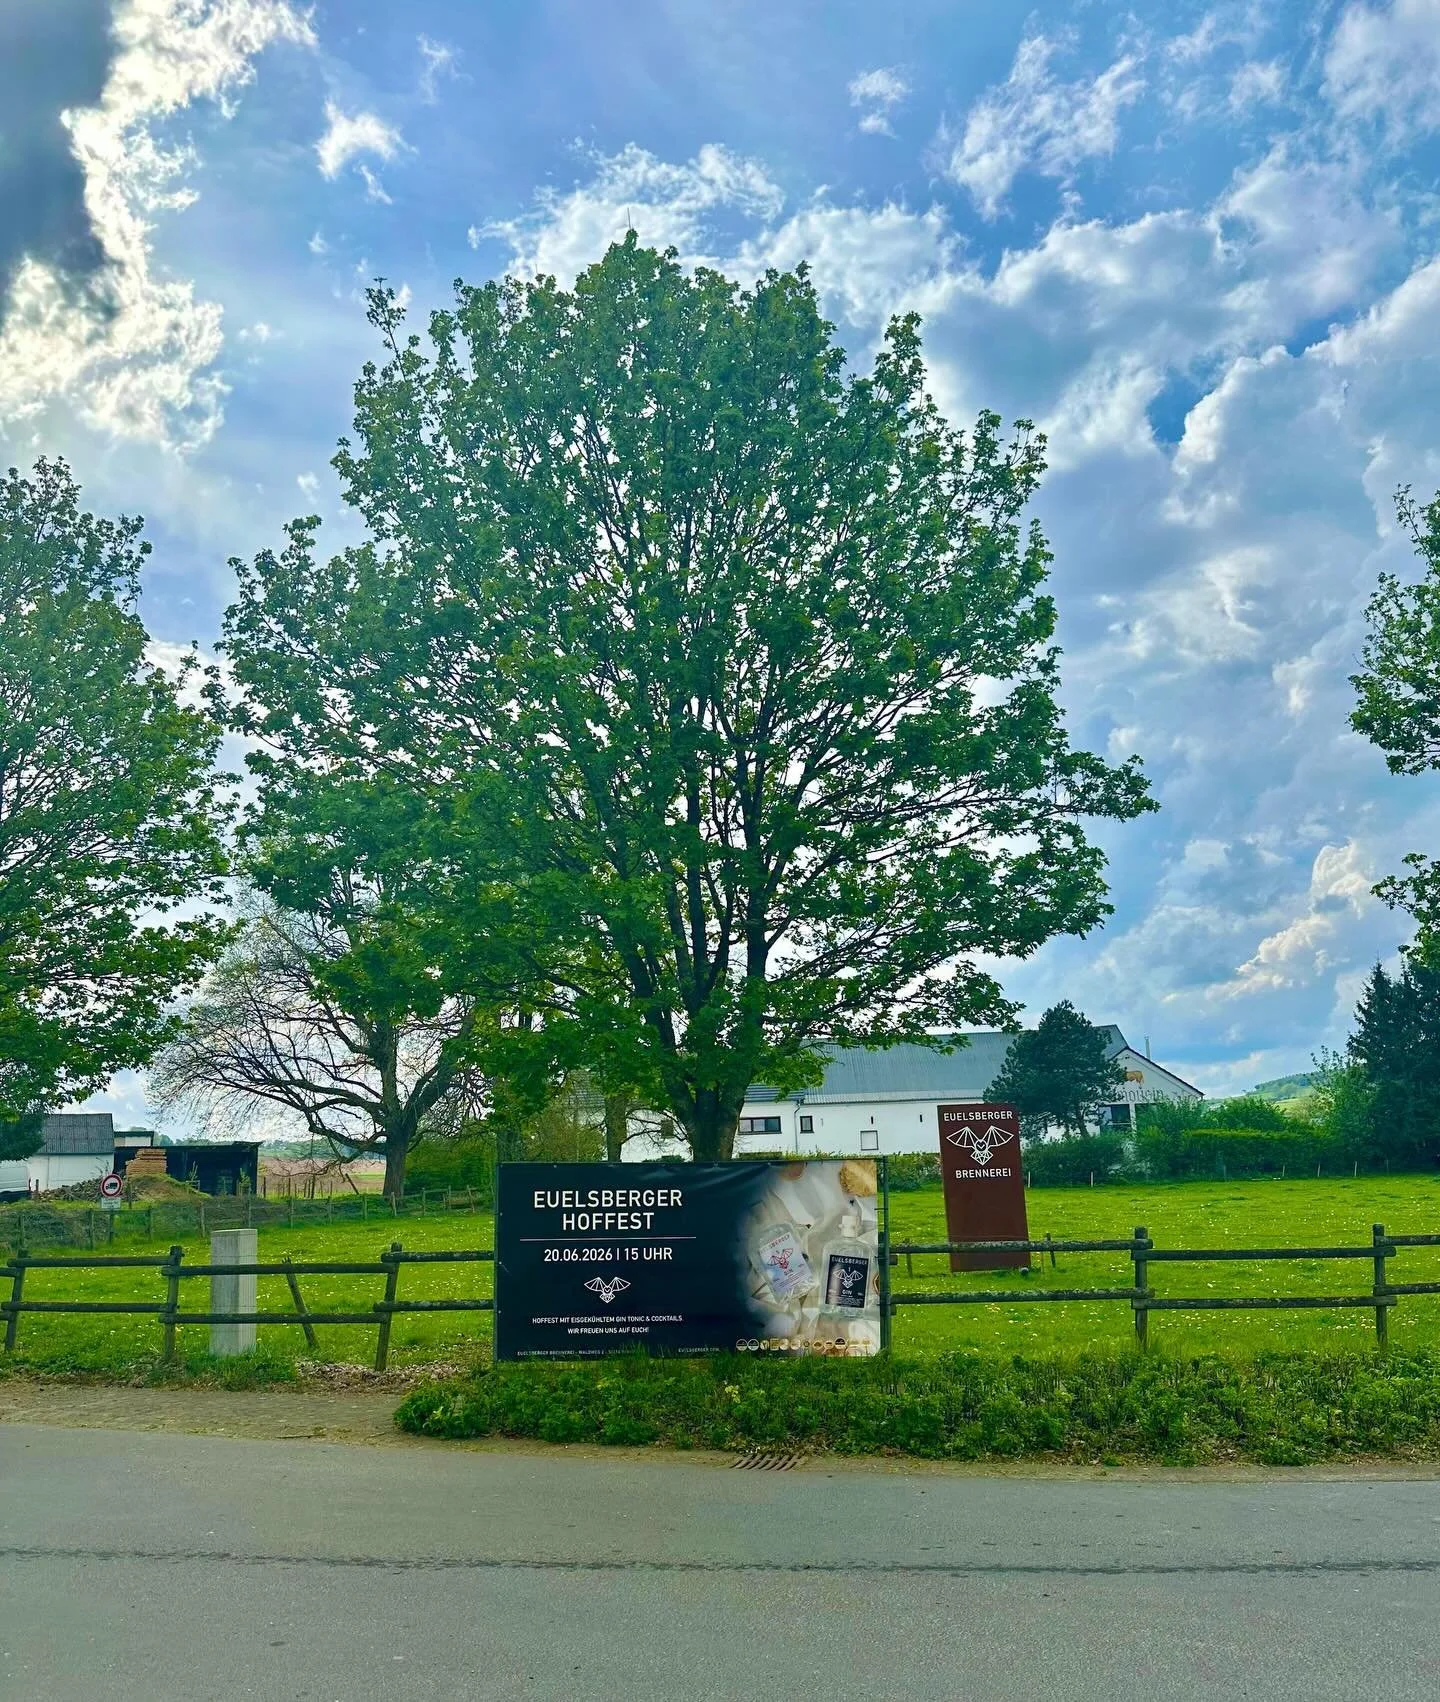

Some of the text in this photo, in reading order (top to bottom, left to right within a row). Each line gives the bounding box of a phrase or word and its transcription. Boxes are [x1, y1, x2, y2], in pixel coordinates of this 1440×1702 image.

[943, 1110, 1013, 1122] EUELSBERGER
[955, 1167, 1012, 1179] BRENNEREI
[534, 1189, 683, 1209] EUELSBERGER
[562, 1212, 655, 1231] HOFFEST
[543, 1248, 613, 1262] 20.06.2026
[624, 1247, 639, 1261] 15
[643, 1247, 673, 1261] UHR
[532, 1316, 558, 1324] HOFFEST
[559, 1316, 570, 1324] MIT
[615, 1315, 627, 1323] GIN
[567, 1327, 580, 1335] WIR
[618, 1326, 631, 1334] AUF
